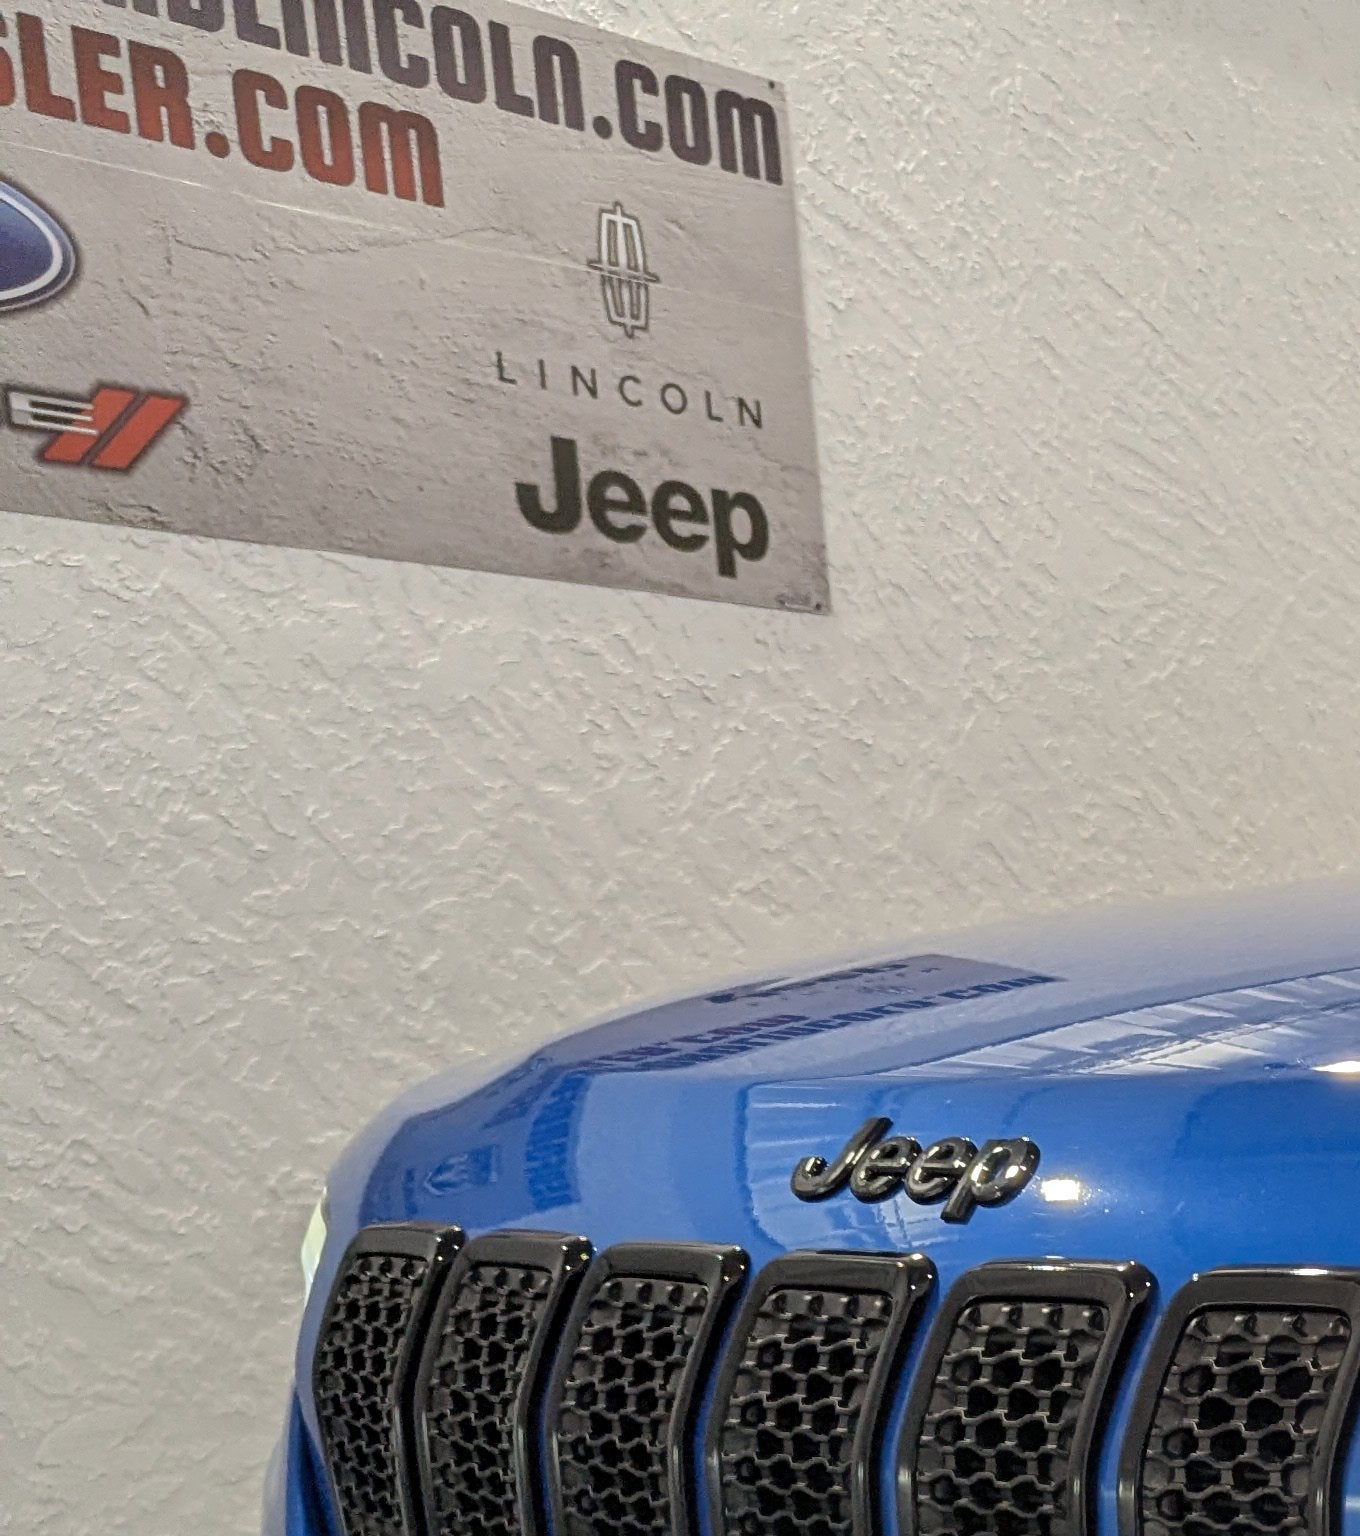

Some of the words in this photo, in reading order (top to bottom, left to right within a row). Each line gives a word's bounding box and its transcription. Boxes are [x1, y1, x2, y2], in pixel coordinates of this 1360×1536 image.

[495, 350, 763, 429] LINCOLN
[514, 435, 770, 579] Jeep
[790, 1115, 1041, 1225] Jeep
